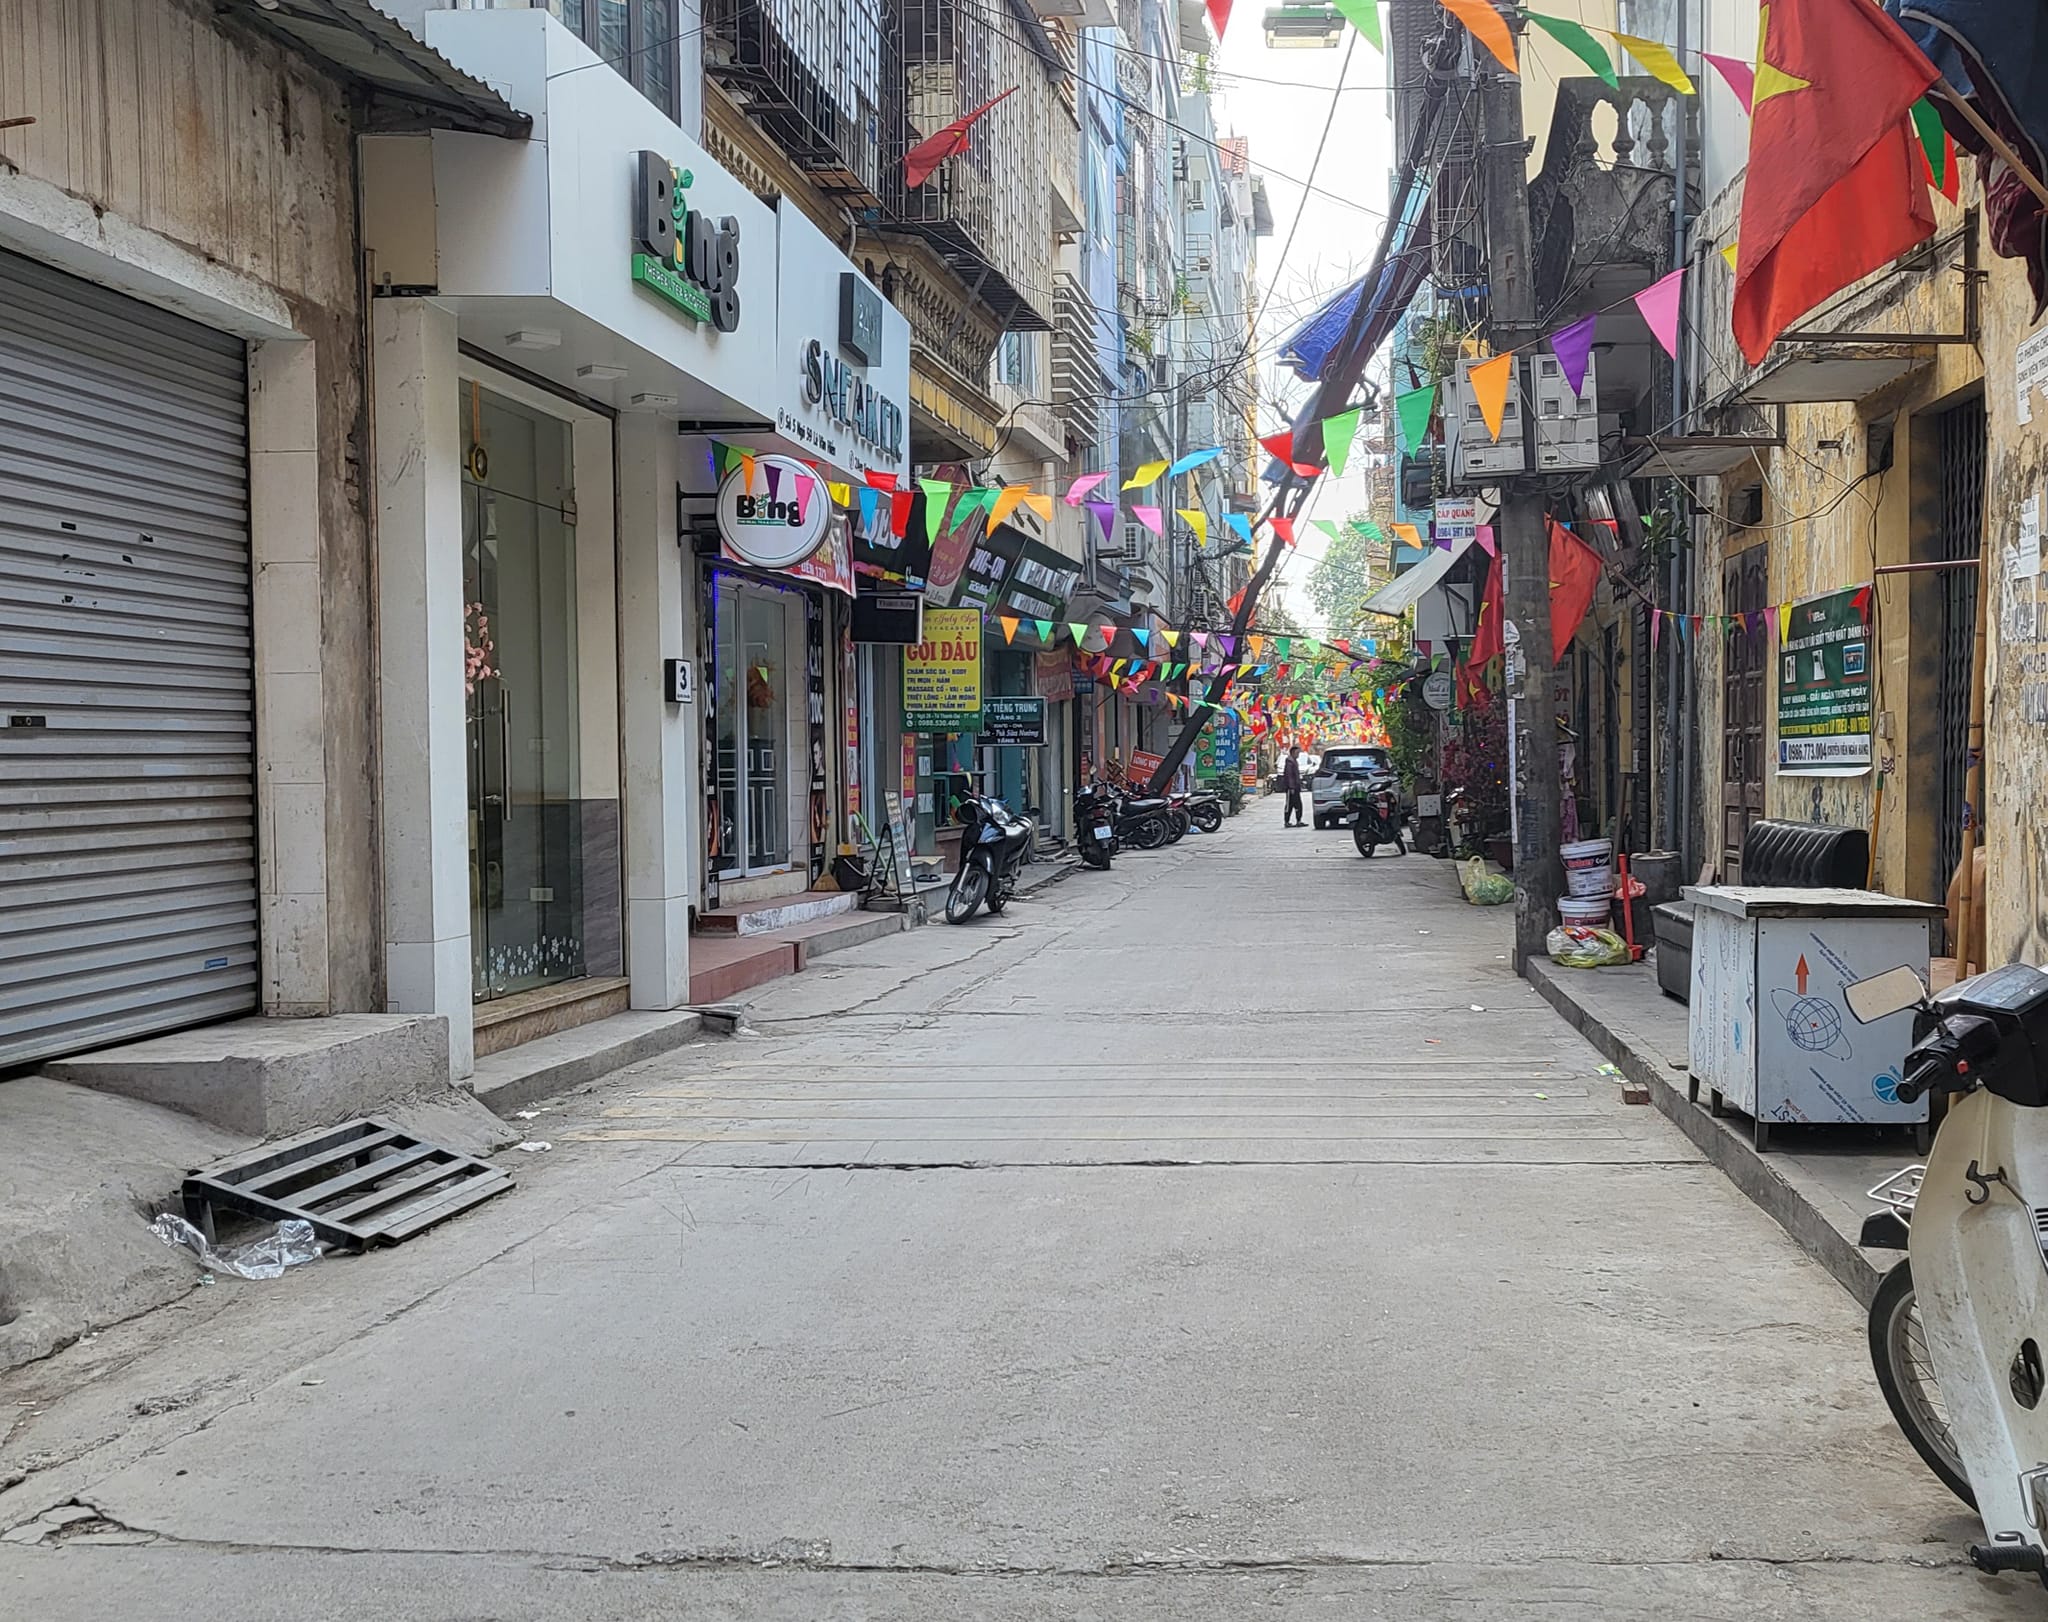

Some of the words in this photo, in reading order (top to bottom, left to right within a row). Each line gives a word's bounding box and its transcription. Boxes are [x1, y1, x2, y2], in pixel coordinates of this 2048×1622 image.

[801, 338, 903, 463] SNEAKER
[1452, 508, 1475, 519] QUANG
[680, 666, 687, 690] 3
